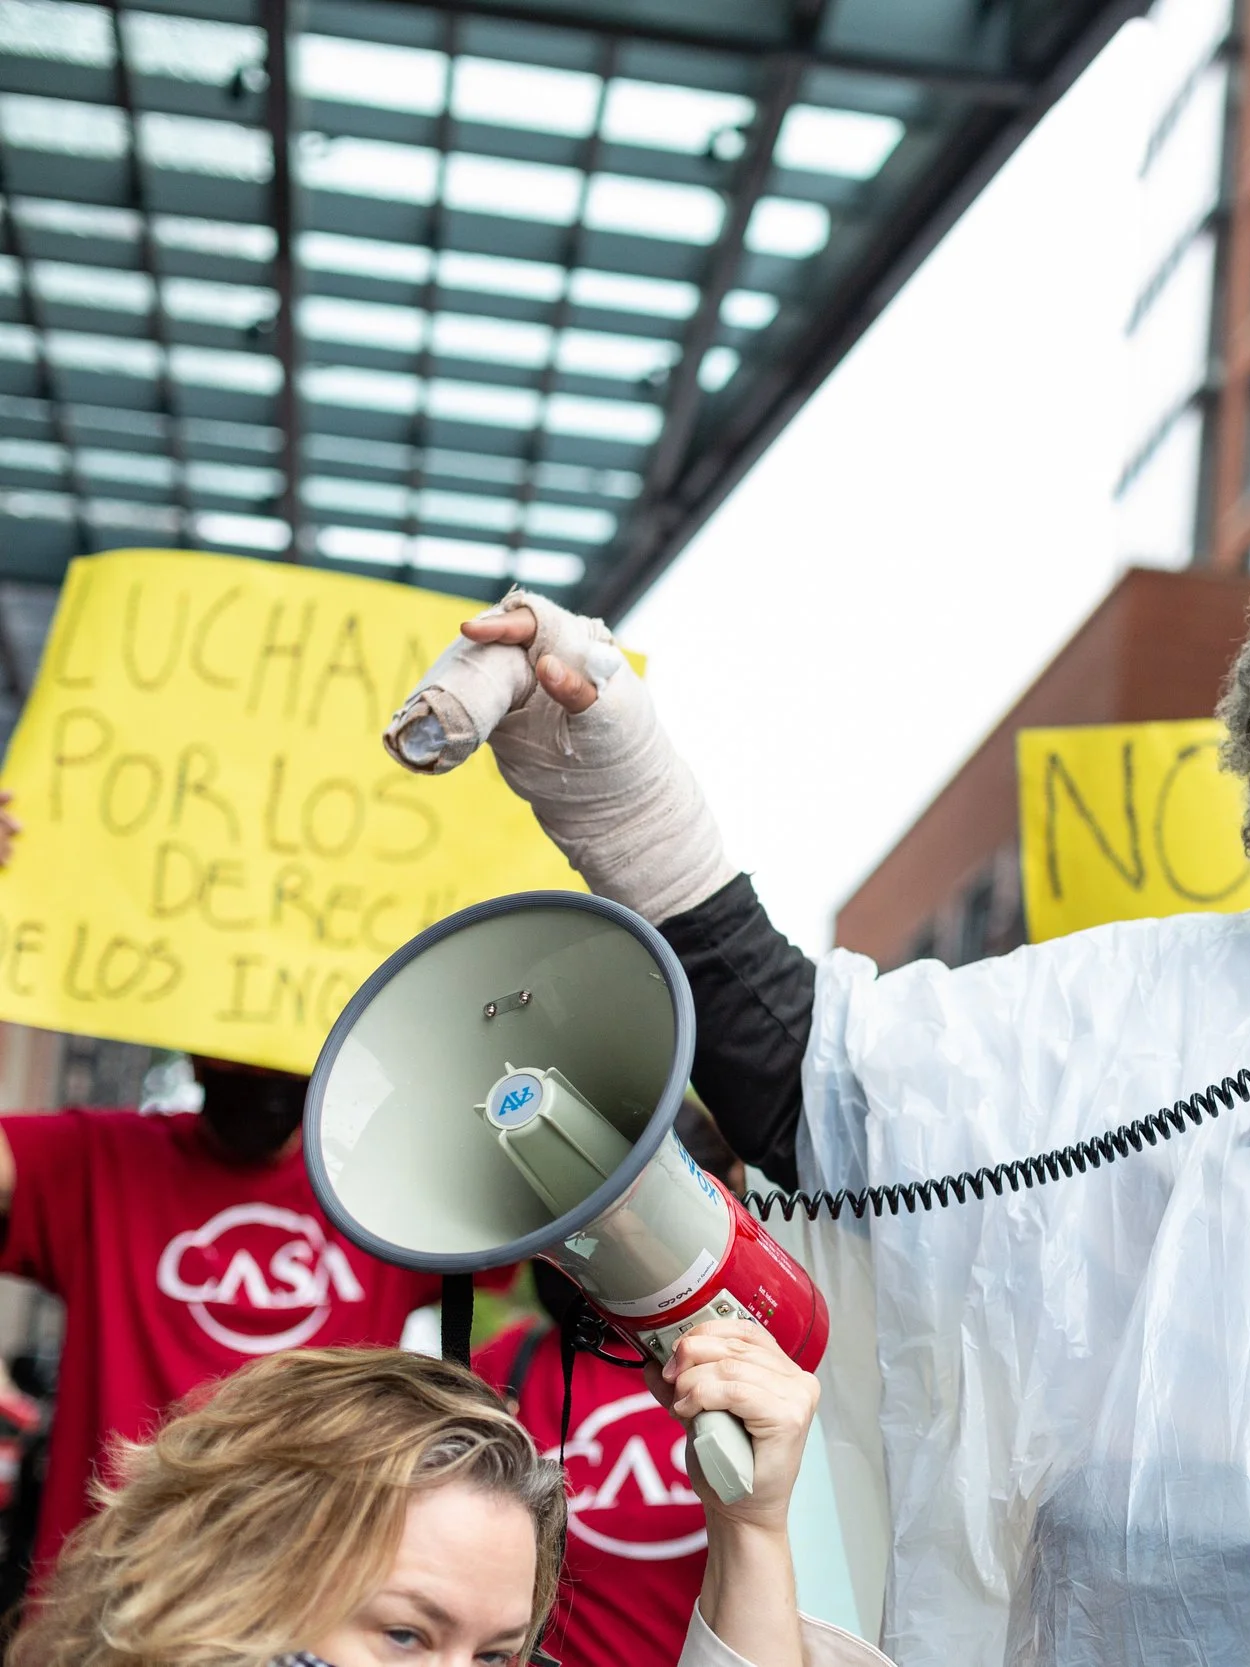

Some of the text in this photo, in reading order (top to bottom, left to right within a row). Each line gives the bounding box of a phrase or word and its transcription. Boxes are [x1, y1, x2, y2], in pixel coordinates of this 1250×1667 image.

[49, 706, 442, 866] POR LOS
[62, 921, 184, 1003] LOS
[155, 1228, 366, 1310] CASA
